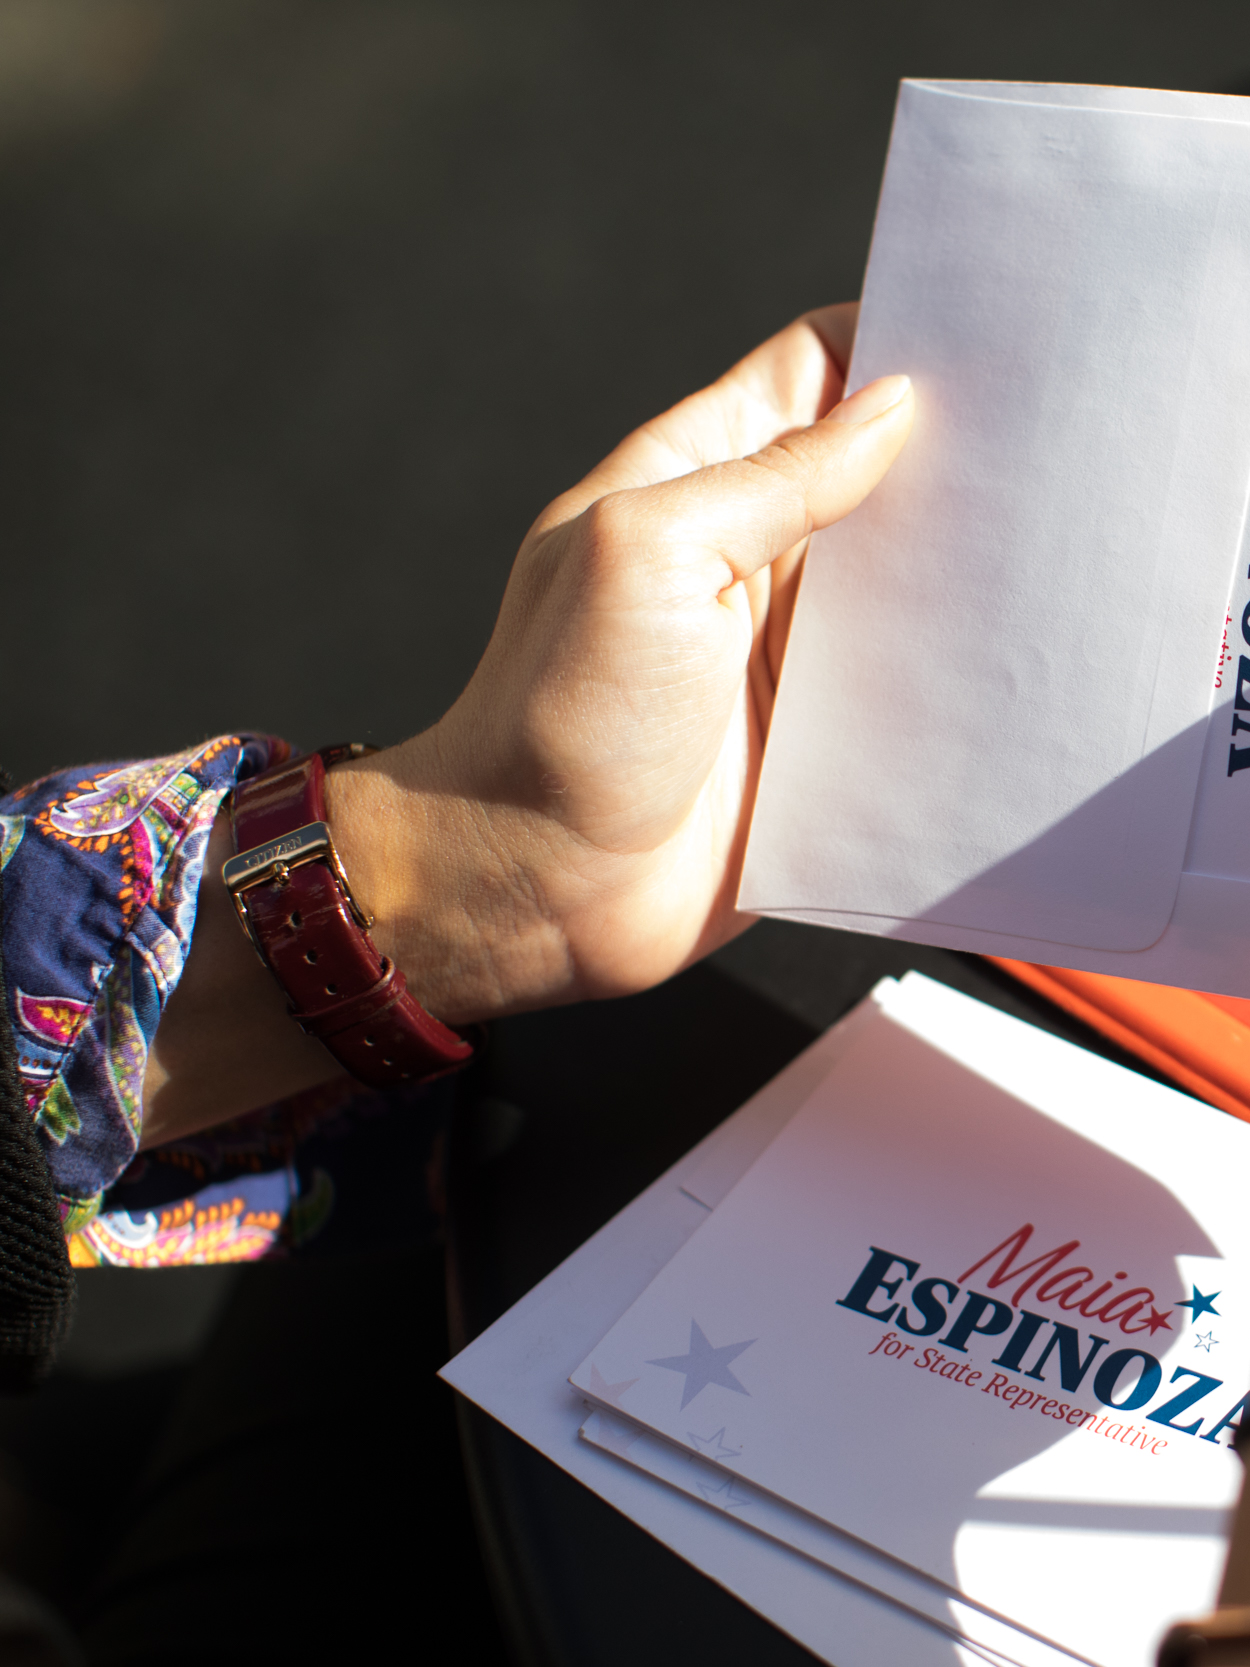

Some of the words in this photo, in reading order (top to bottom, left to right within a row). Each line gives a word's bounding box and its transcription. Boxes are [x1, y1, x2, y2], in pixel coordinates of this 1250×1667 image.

[244, 836, 304, 869] CITIZEN
[957, 1222, 1155, 1335] Maia
[868, 1331, 915, 1360] for
[914, 1347, 983, 1388] State
[981, 1372, 1169, 1456] Representative
